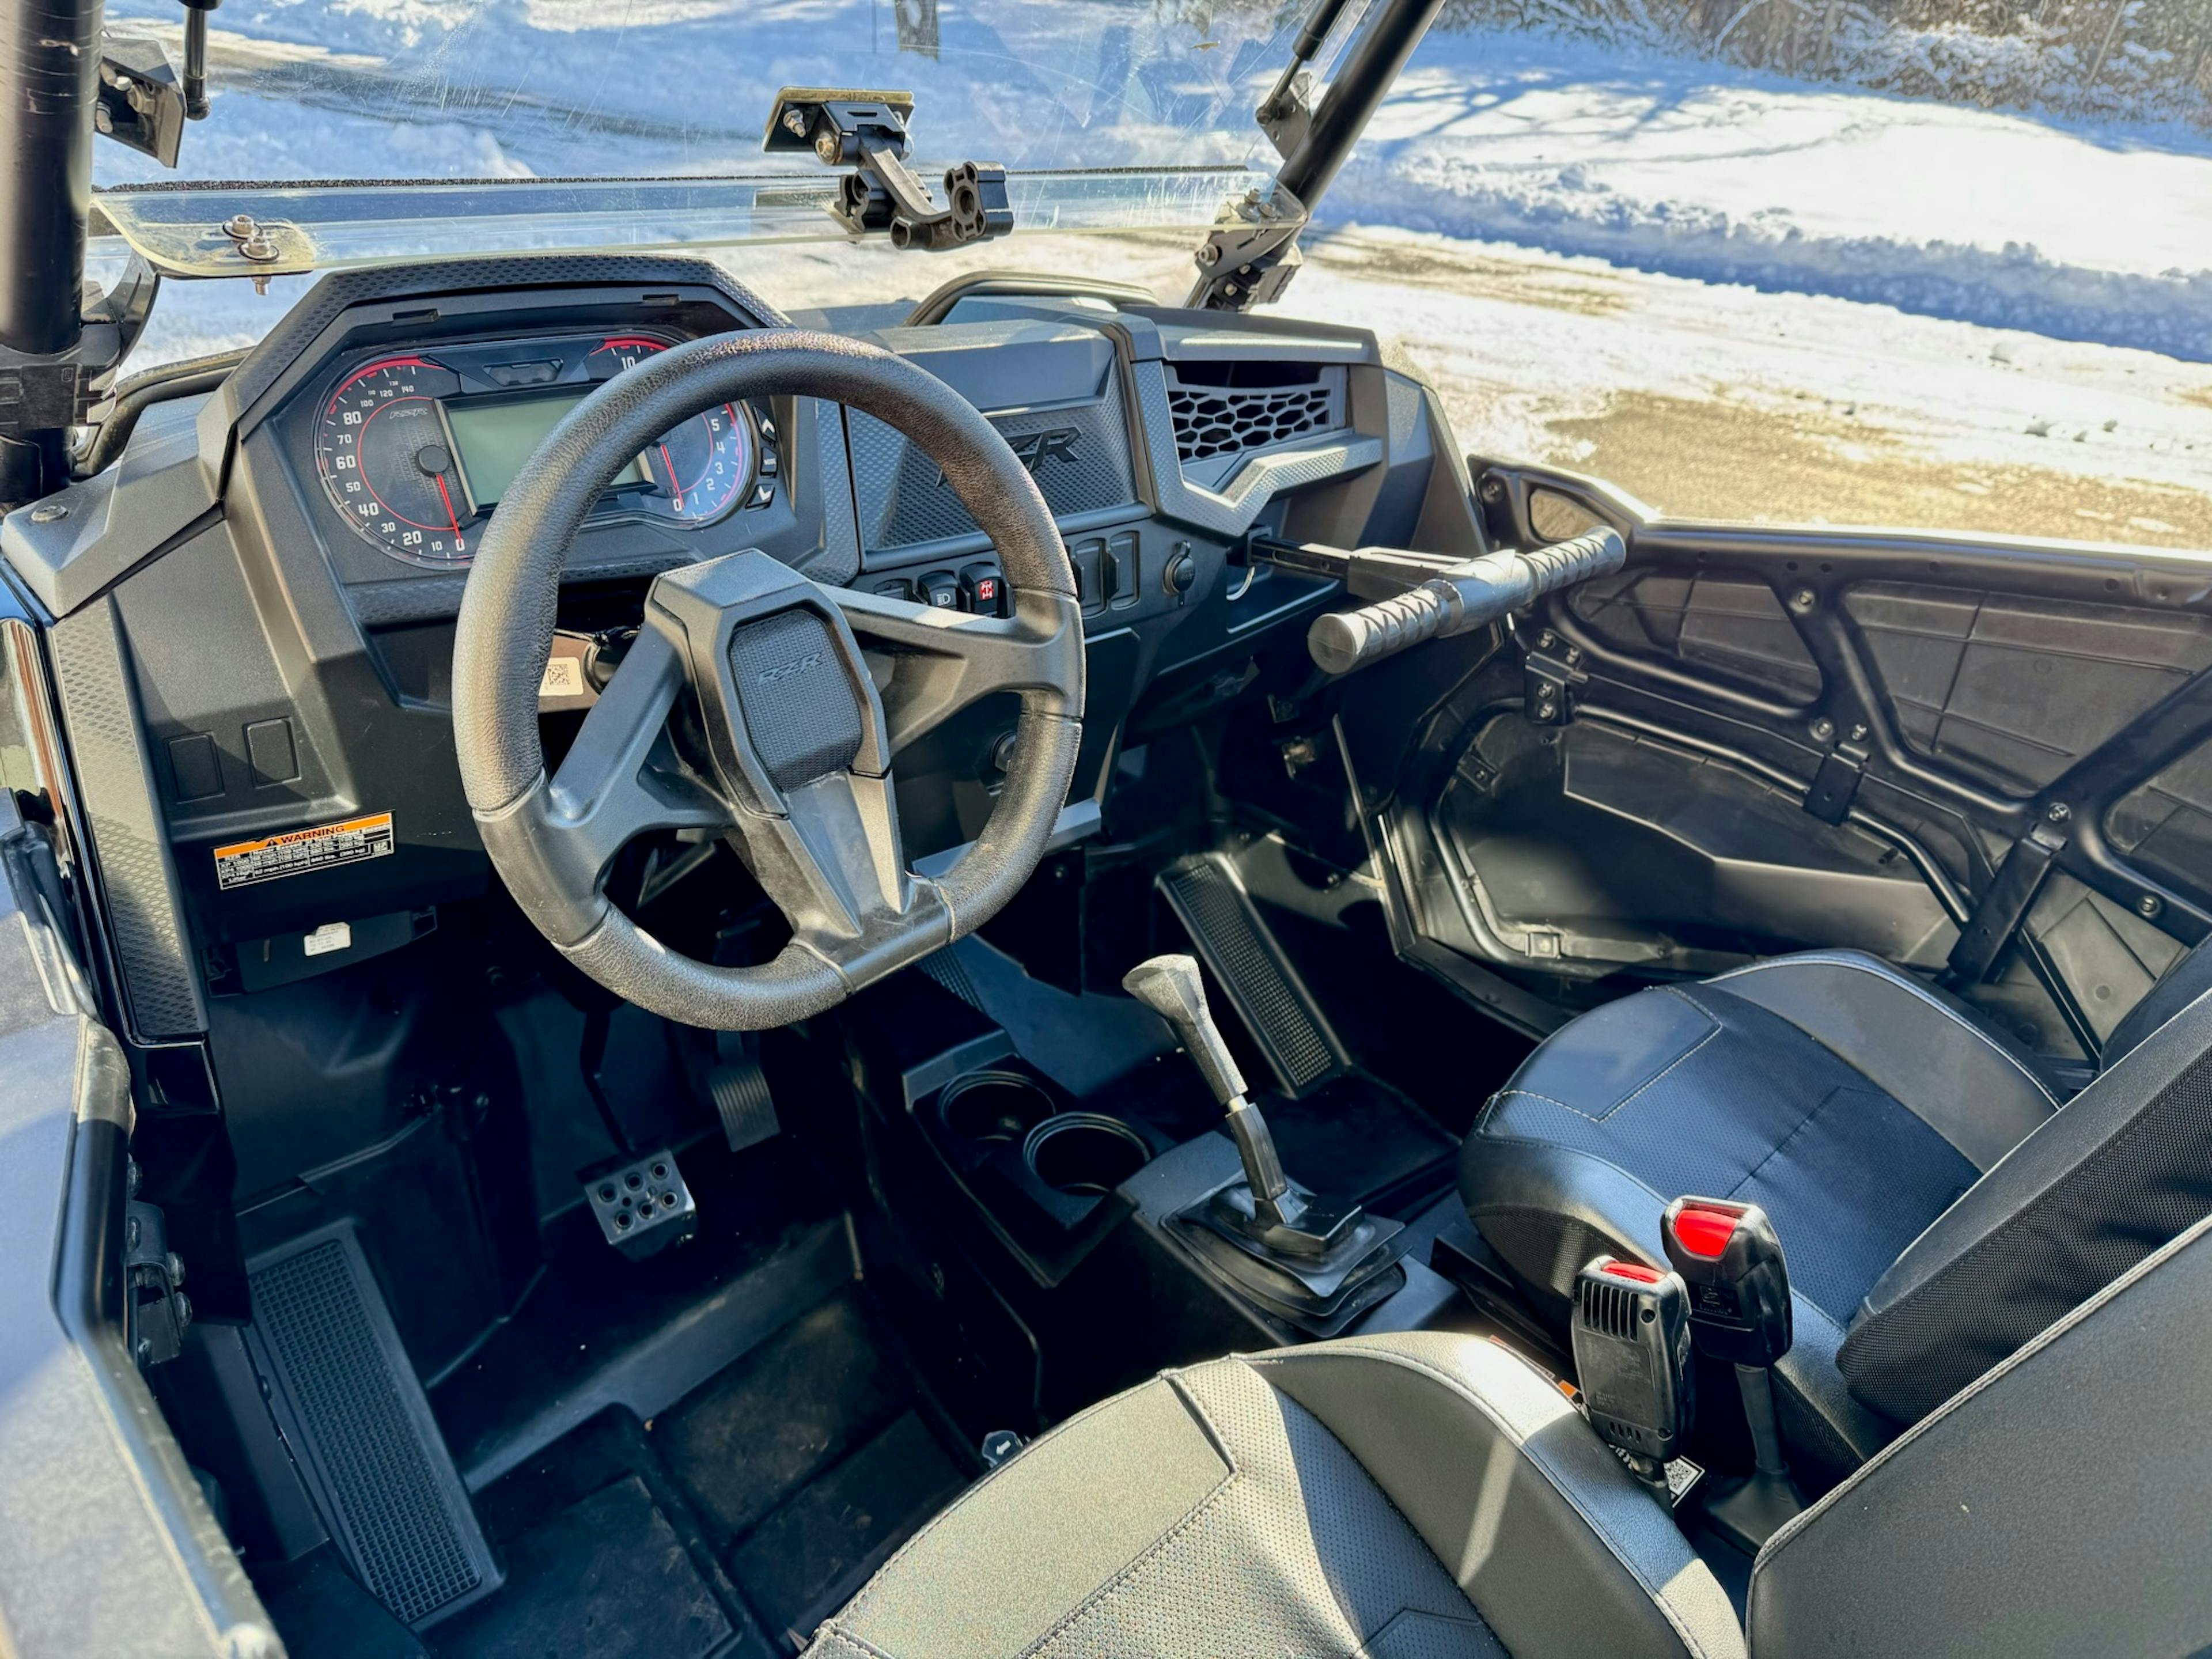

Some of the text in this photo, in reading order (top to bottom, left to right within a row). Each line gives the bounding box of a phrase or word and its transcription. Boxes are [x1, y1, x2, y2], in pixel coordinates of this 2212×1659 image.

[621, 356, 636, 370] 10
[380, 389, 393, 397] 120
[401, 385, 415, 393] 140
[360, 399, 374, 408] 100
[343, 411, 362, 425] 80
[711, 418, 720, 431] 5
[337, 434, 353, 445] 70
[716, 441, 726, 454] 4
[336, 455, 356, 470] 60
[715, 462, 724, 474] 3
[346, 481, 361, 493] 50
[706, 478, 715, 490] 2
[693, 493, 699, 504] 1
[358, 502, 379, 516] 40
[672, 498, 683, 512] 0
[382, 521, 396, 533] 30
[403, 531, 422, 546] 20
[431, 541, 443, 552] 10
[456, 538, 465, 552] 0
[281, 825, 344, 843] WARNING
